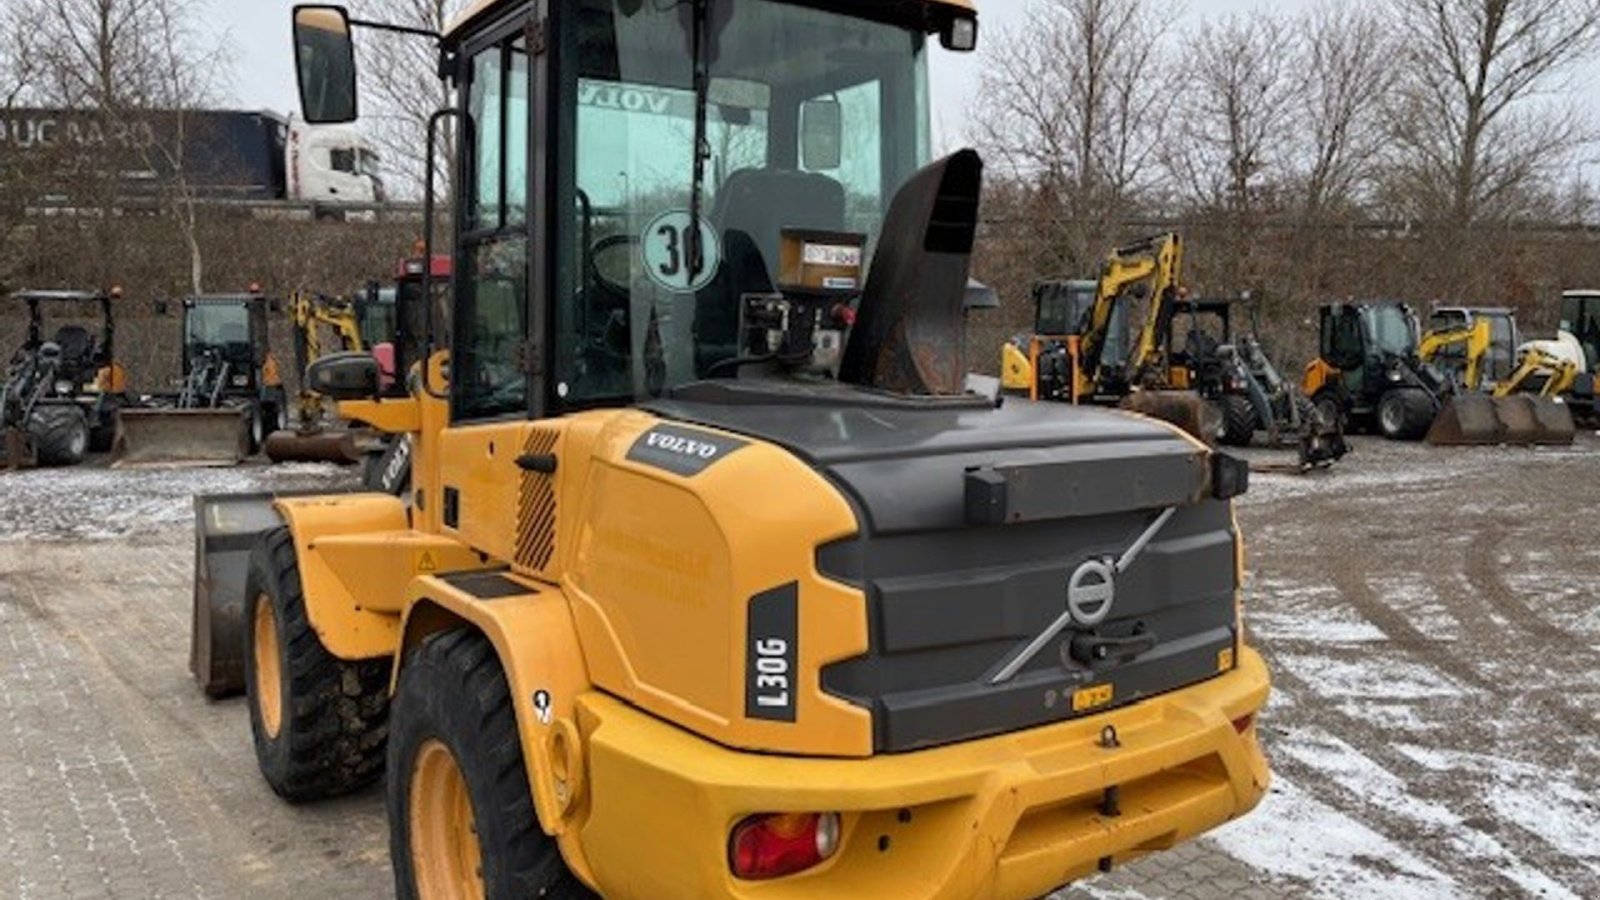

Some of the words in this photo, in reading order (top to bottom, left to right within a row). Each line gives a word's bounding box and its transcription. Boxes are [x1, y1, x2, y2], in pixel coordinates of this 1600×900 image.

[657, 224, 703, 276] 30
[647, 432, 717, 458] VOLVO
[757, 638, 788, 706] L30G
